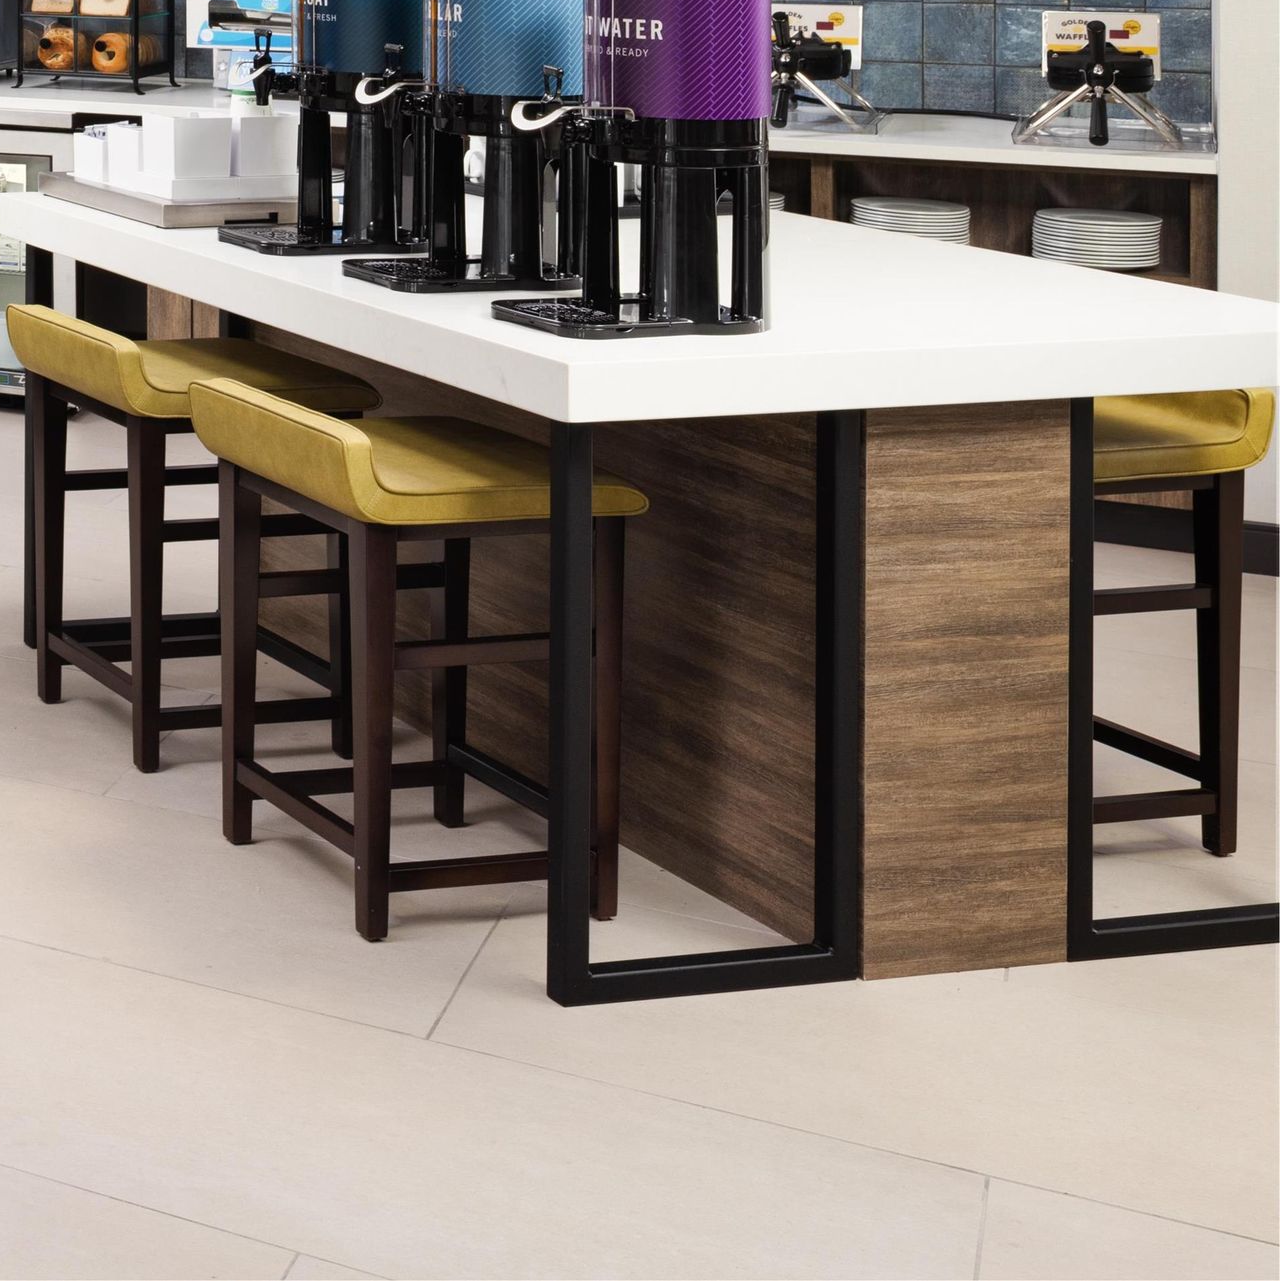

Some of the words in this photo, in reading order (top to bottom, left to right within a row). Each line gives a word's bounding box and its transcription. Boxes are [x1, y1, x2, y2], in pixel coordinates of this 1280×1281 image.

[1061, 19, 1088, 27] GOLDE
[599, 16, 664, 40] WATER
[1055, 33, 1089, 41] WAFFL
[615, 47, 649, 58] READY
